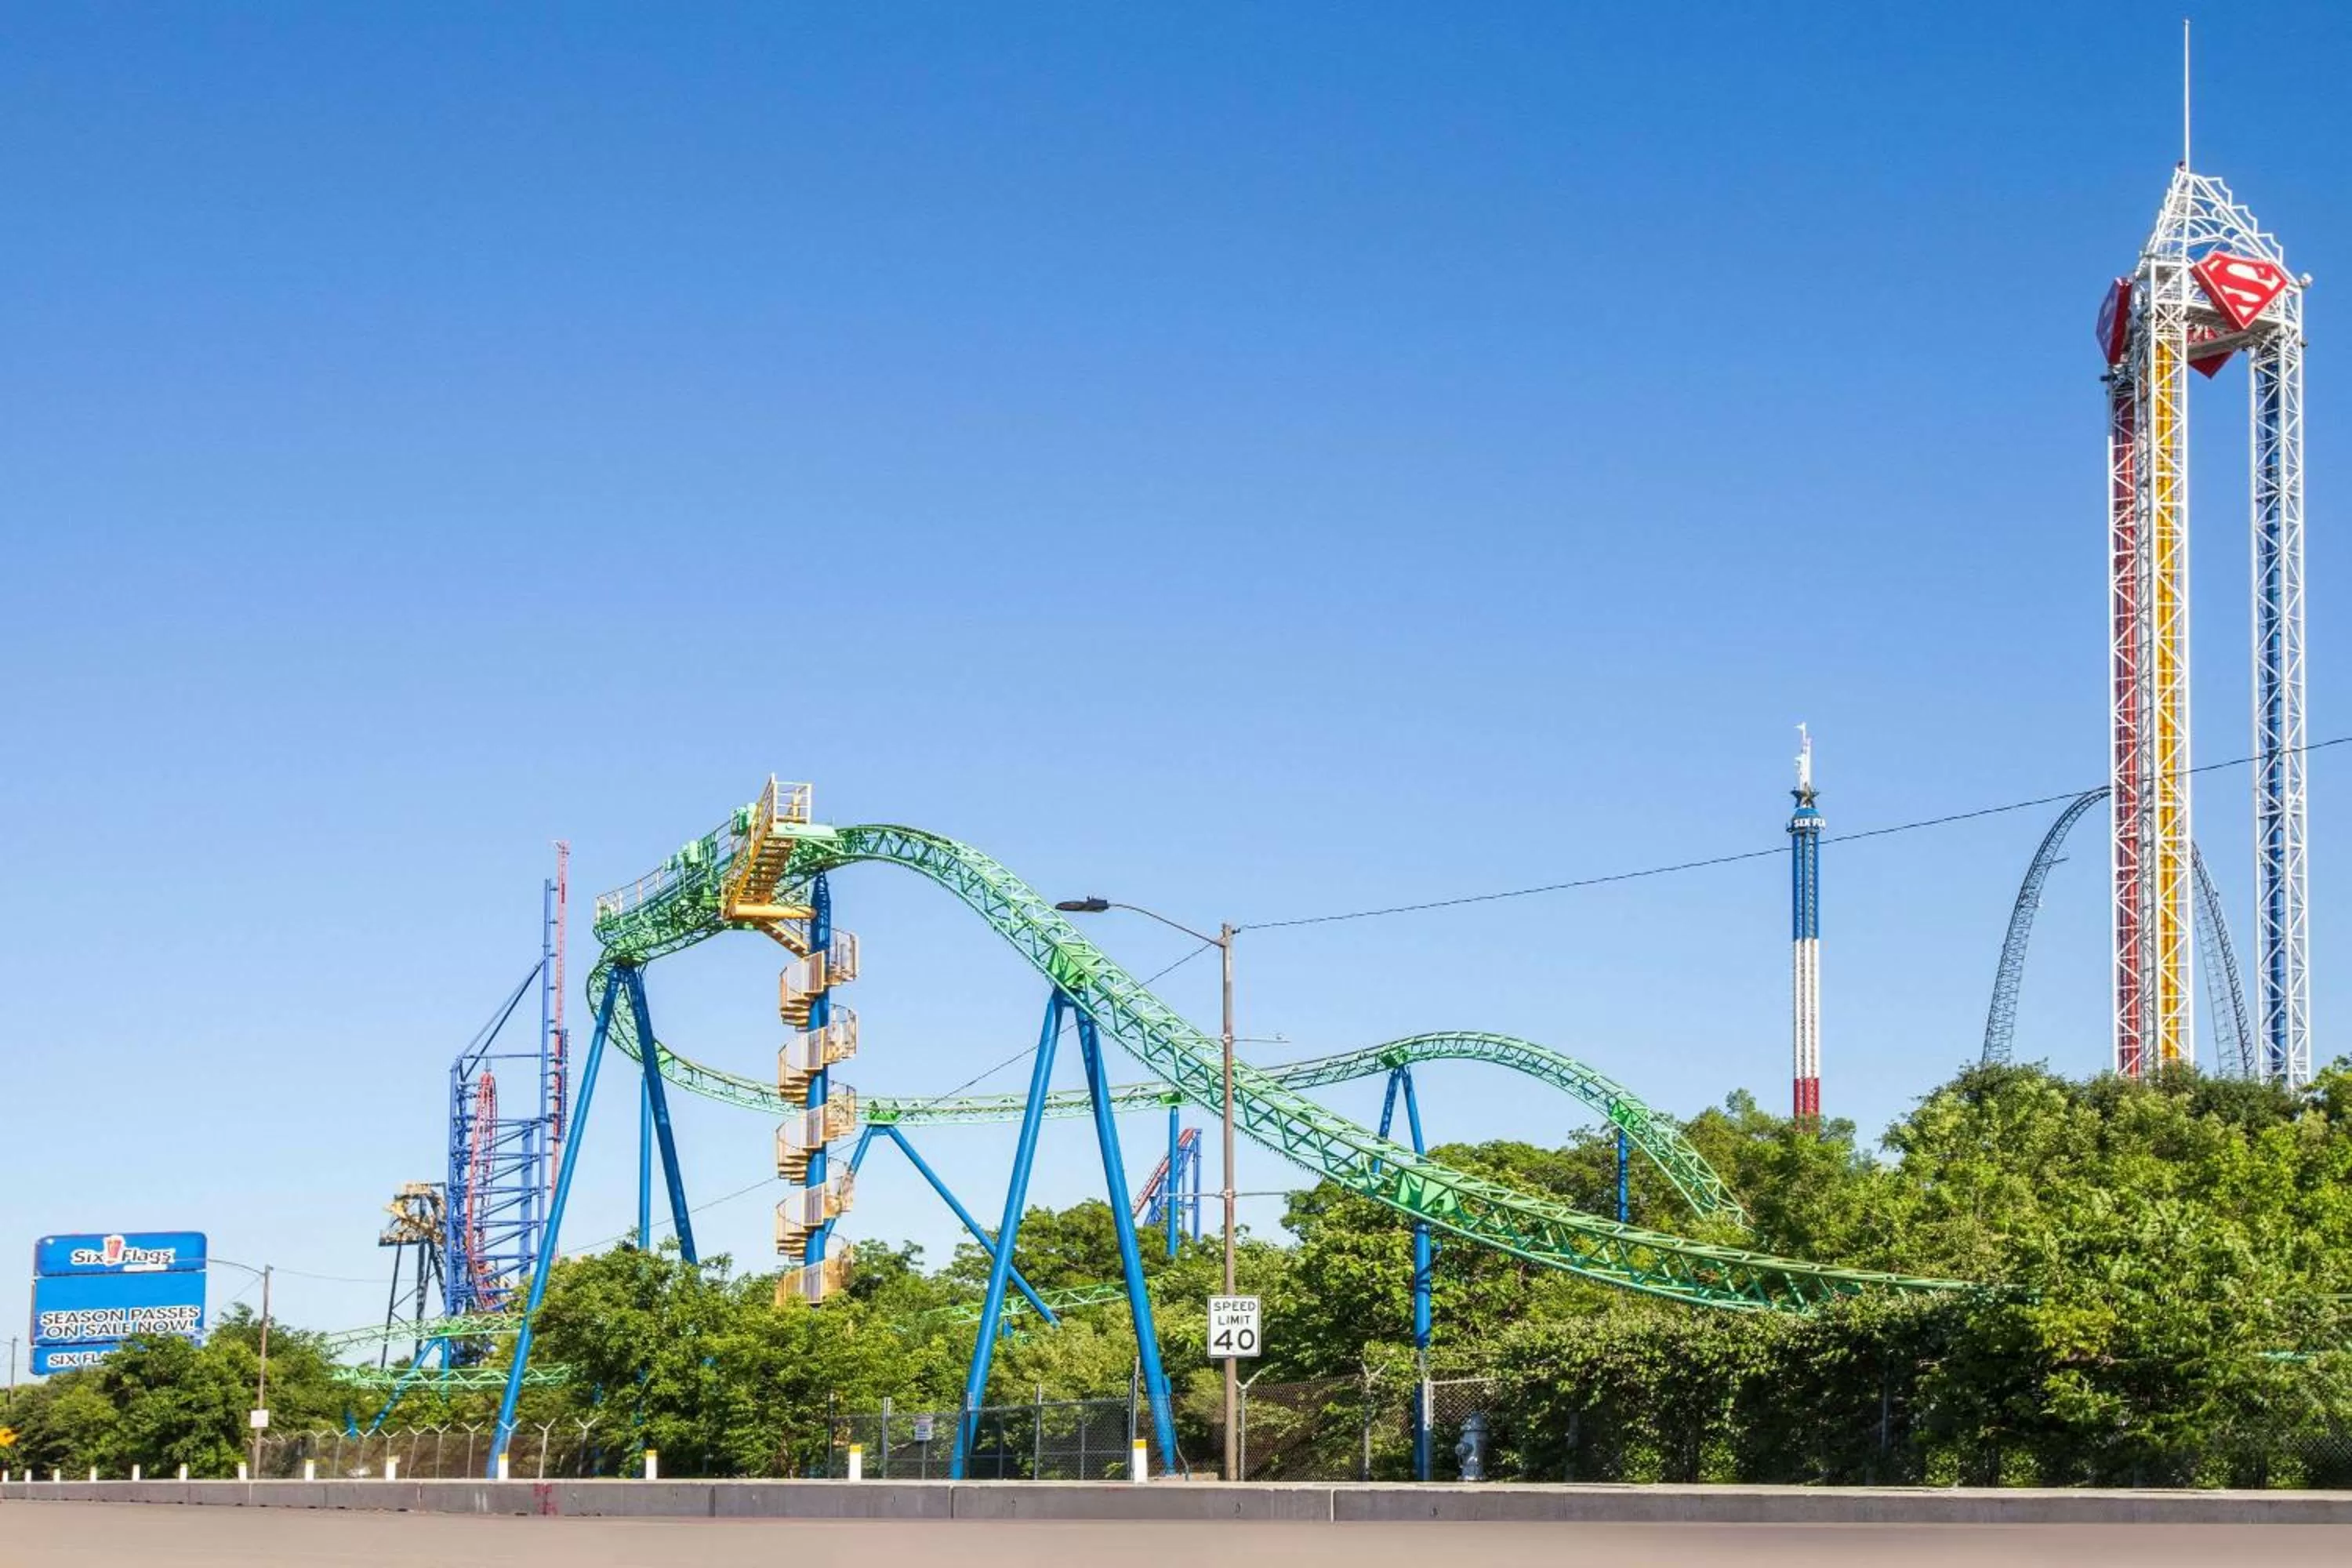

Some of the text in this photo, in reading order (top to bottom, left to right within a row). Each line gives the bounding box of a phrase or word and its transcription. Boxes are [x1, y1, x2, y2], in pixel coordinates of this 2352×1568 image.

[74, 1248, 172, 1265] Six Flags
[1213, 1301, 1256, 1312] SPEED
[42, 1306, 199, 1326] SEASON PASSES
[1218, 1315, 1250, 1326] LIMIT
[45, 1320, 195, 1338] ON SALE NOW!
[1213, 1328, 1255, 1351] 40
[49, 1354, 77, 1366] SIX
